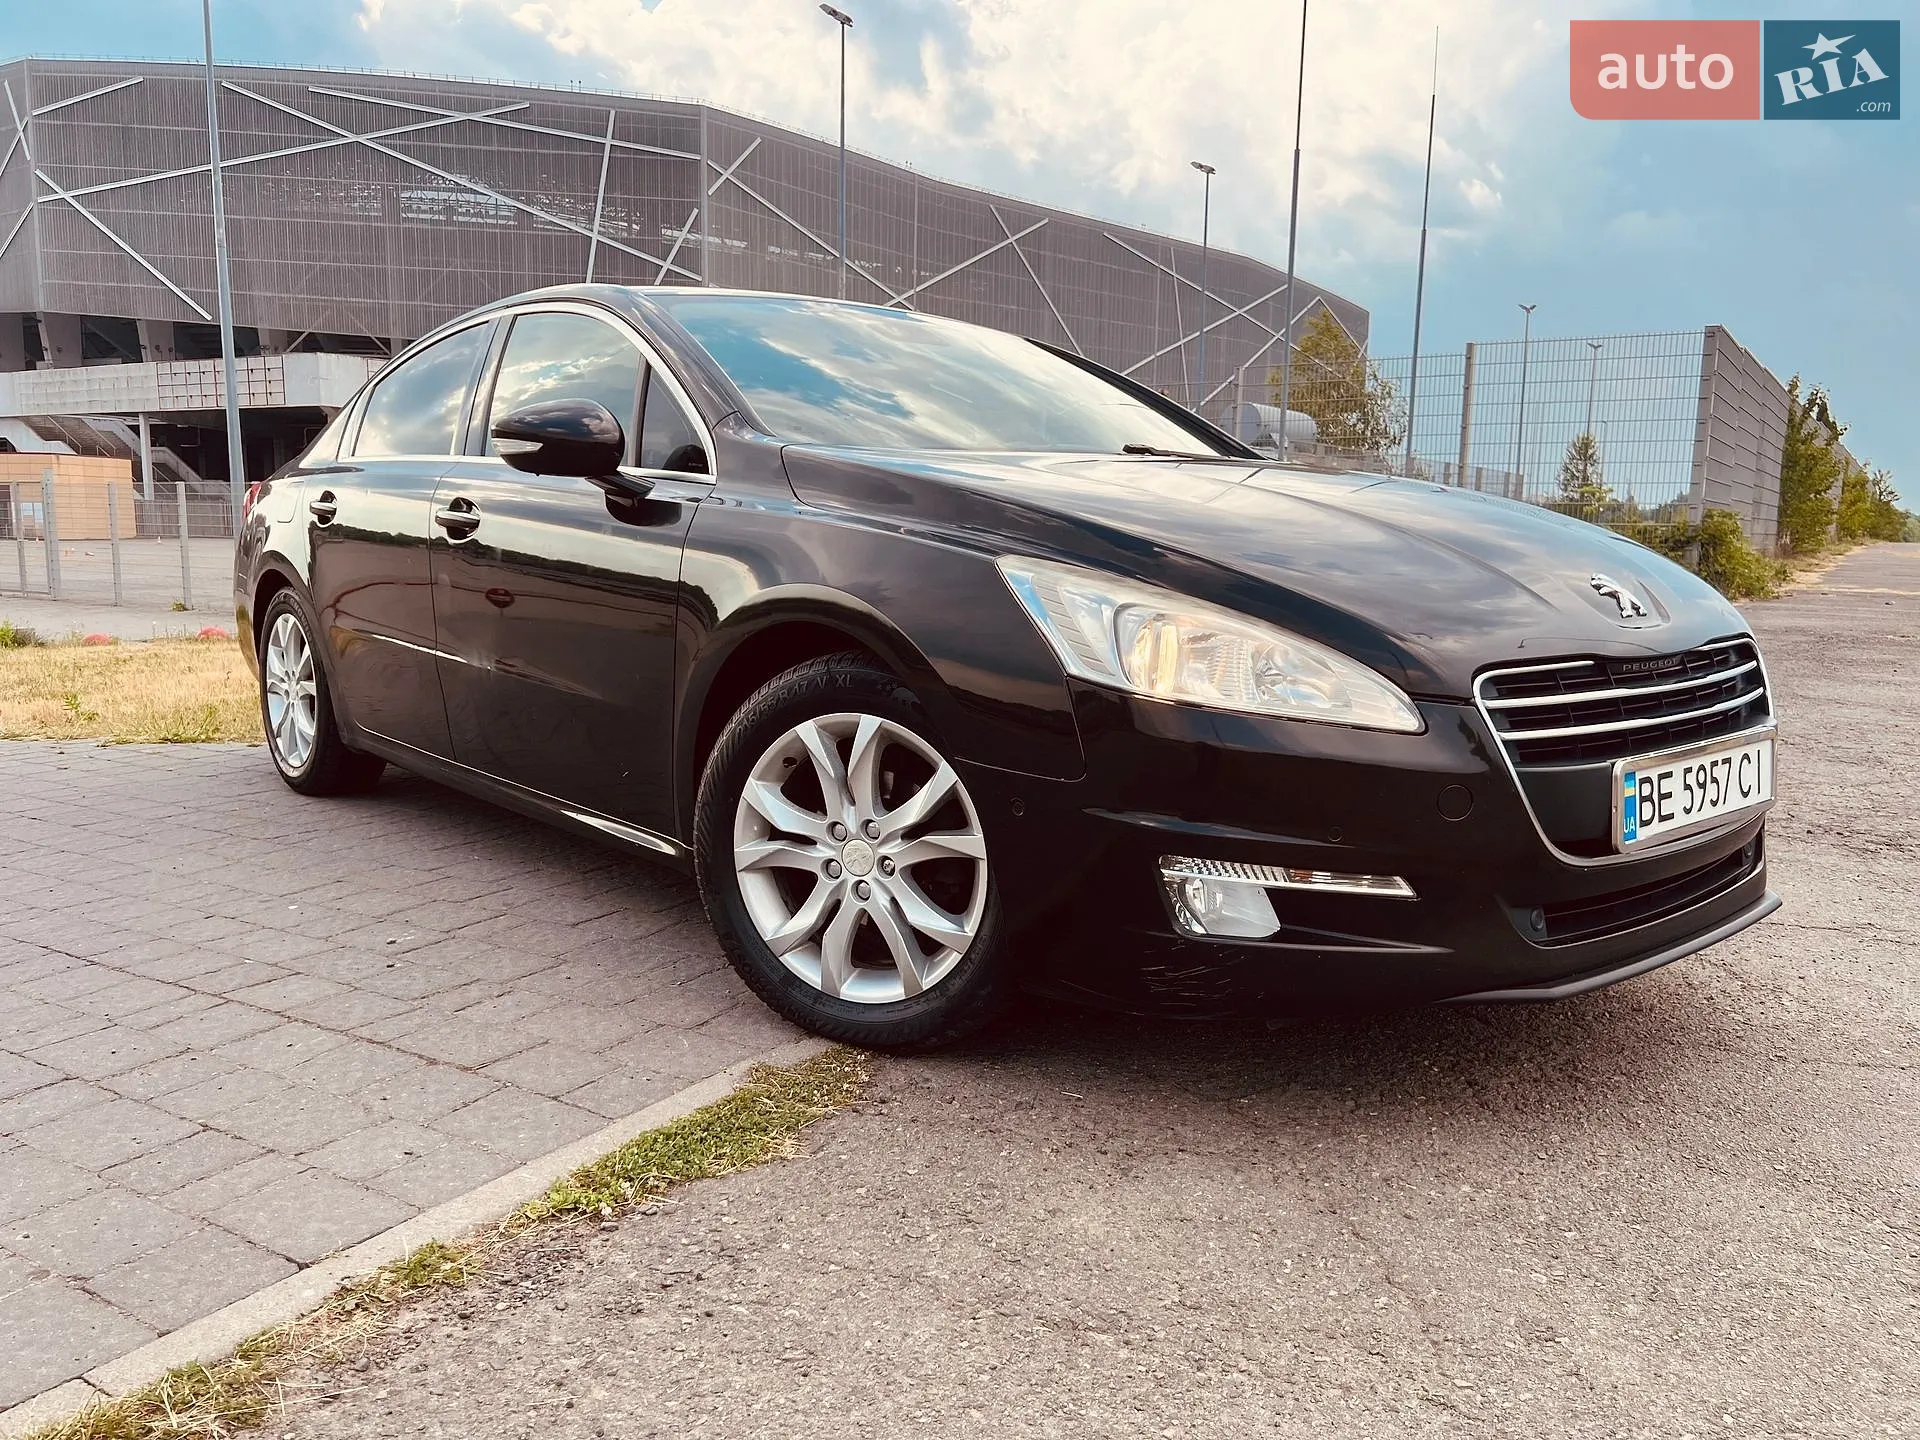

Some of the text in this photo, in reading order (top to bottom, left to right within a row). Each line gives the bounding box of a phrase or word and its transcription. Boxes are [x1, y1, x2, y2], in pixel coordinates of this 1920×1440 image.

[1623, 658, 1677, 672] PEUGEOT
[1638, 749, 1761, 828] BE 5957 CI
[1623, 816, 1636, 833] UA
